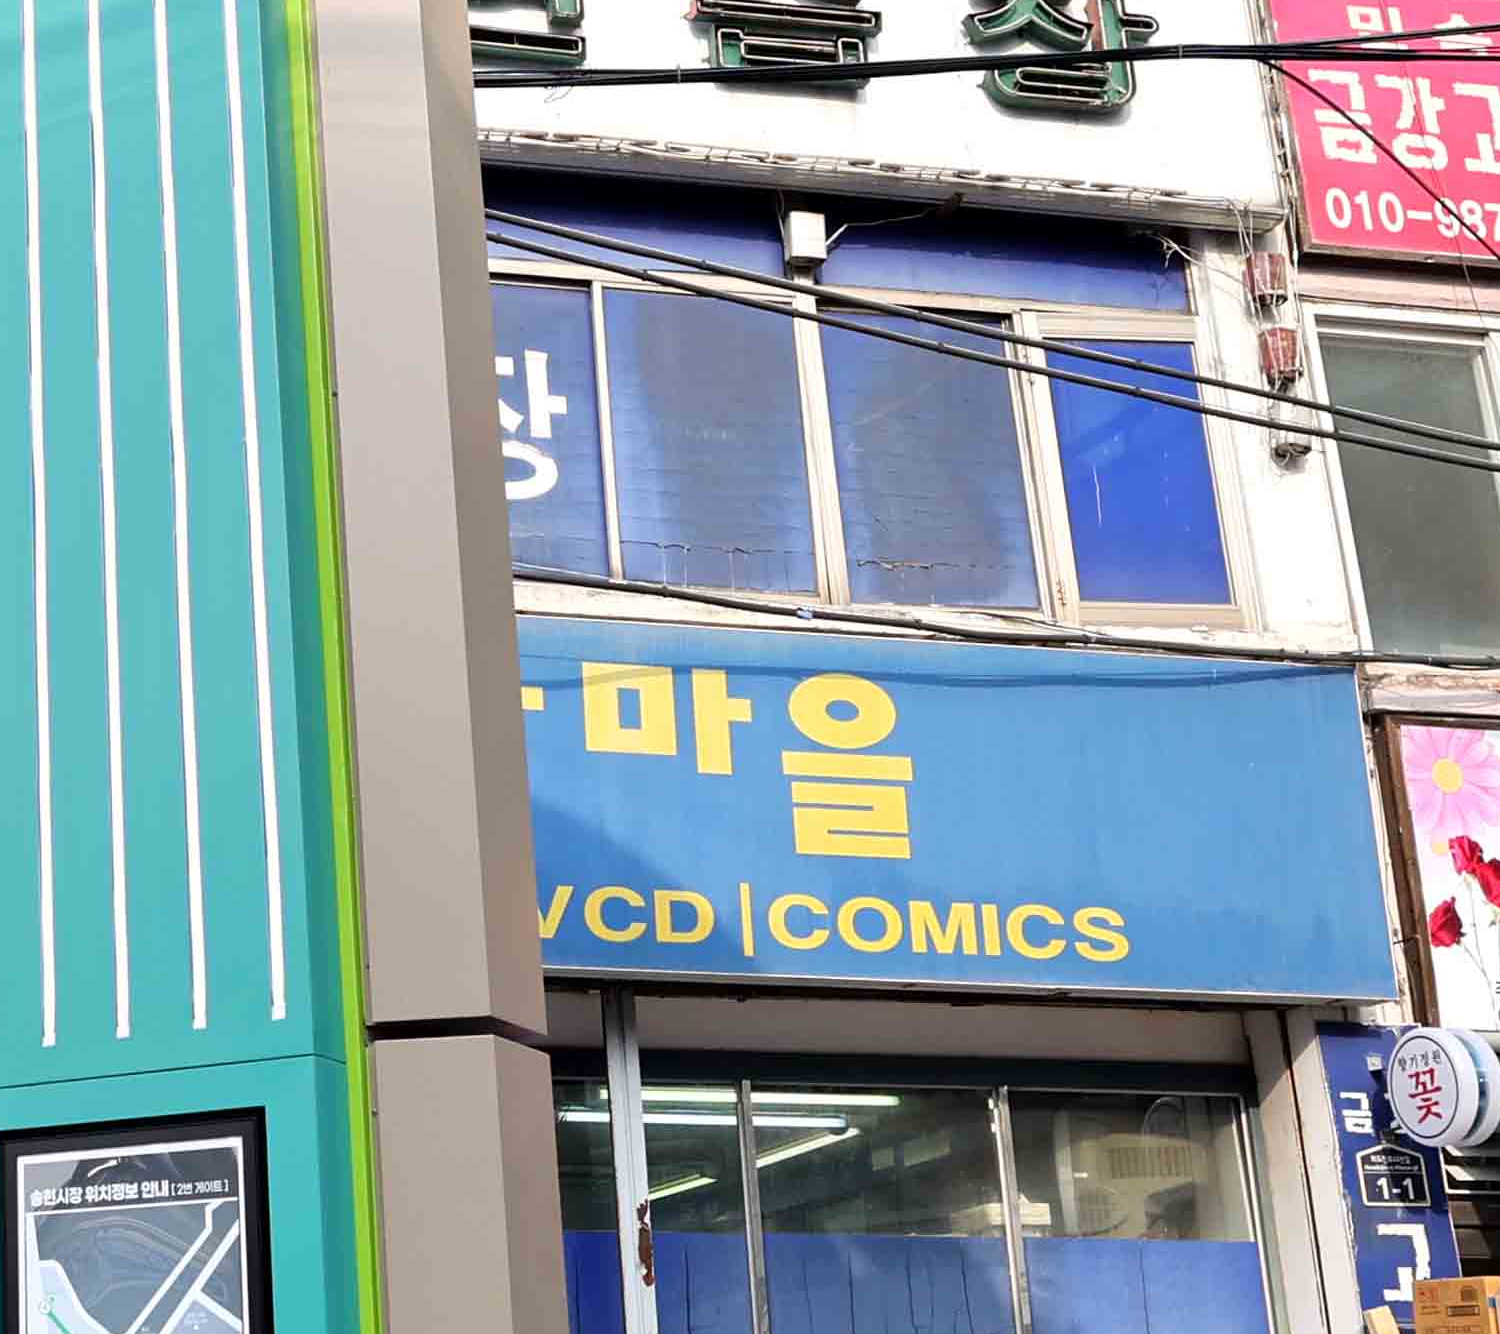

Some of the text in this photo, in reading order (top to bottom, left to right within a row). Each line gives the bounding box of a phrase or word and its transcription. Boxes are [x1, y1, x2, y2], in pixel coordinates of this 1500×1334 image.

[522, 661, 914, 860] 마을
[767, 892, 1132, 964] COMICS
[1407, 1067, 1443, 1124] 꽃
[84, 1181, 139, 1203] 위치정보
[140, 1179, 170, 1199] 안내
[1375, 1176, 1416, 1201] 1-1
